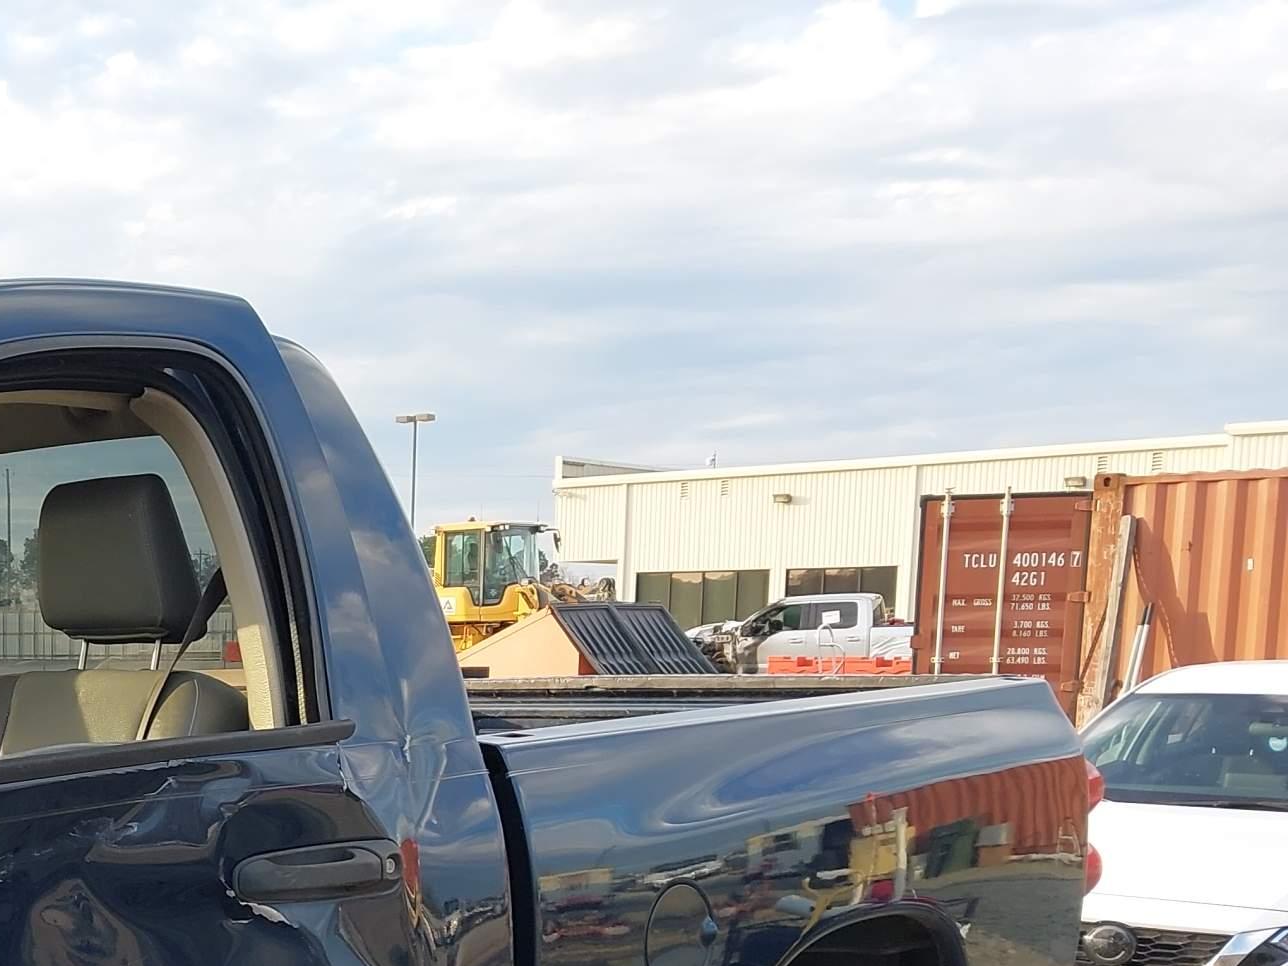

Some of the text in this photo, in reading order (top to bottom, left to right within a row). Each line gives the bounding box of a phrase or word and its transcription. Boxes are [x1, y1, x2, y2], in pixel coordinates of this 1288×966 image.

[964, 551, 1082, 568] TCLU 400146 7
[1011, 571, 1046, 586] 42G1
